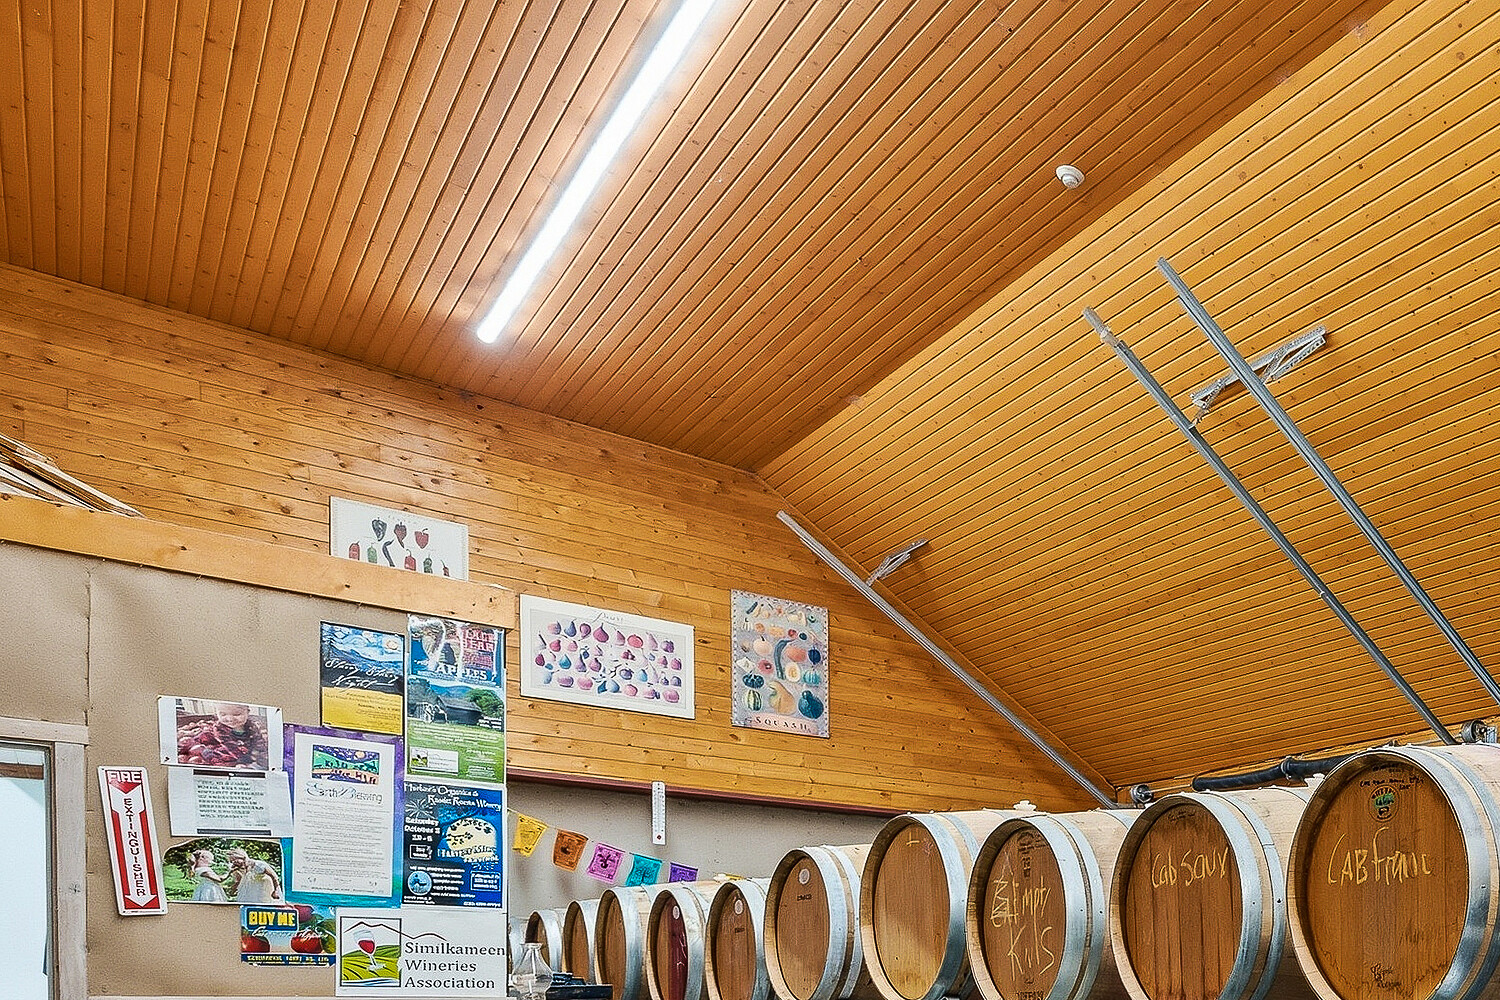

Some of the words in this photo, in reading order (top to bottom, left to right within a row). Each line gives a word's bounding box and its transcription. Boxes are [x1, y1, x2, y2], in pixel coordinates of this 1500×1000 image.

[106, 770, 142, 784] FIRE
[122, 798, 147, 897] EXTINGUISHER
[248, 911, 275, 926] BUY
[277, 912, 296, 927] ME
[404, 941, 506, 957] Similkameen
[404, 958, 478, 973] Wineries
[404, 976, 496, 990] Association
